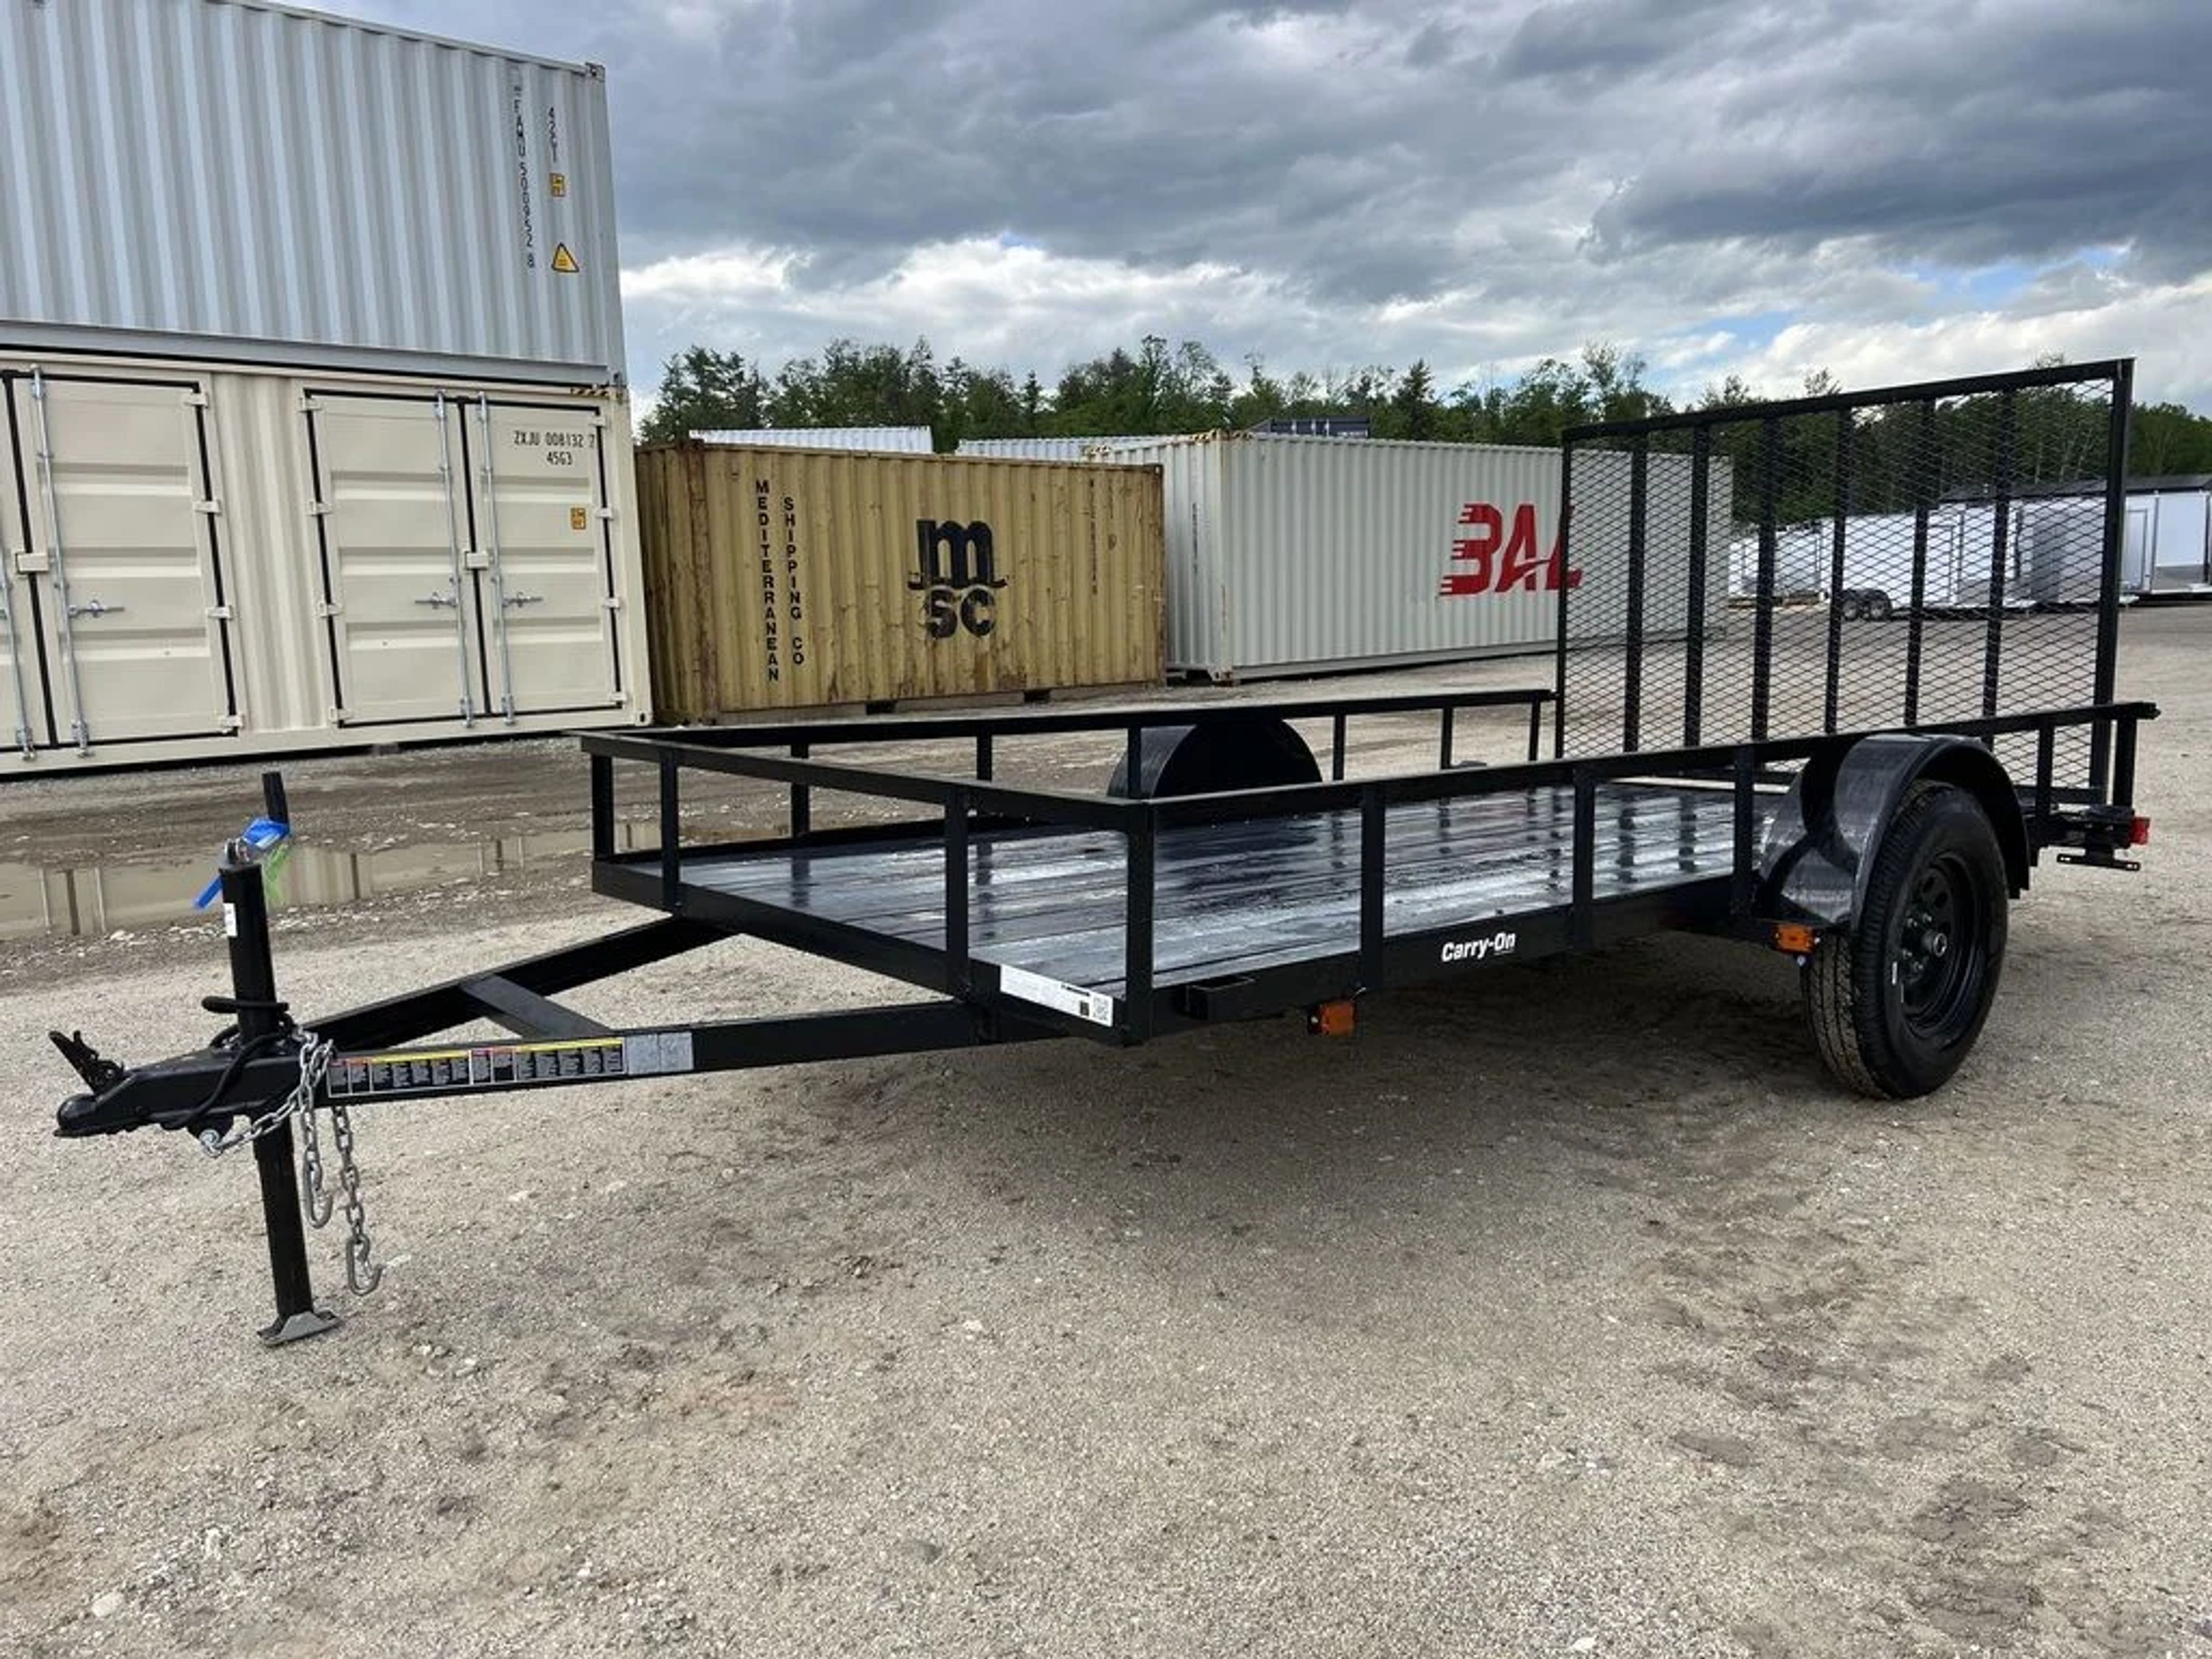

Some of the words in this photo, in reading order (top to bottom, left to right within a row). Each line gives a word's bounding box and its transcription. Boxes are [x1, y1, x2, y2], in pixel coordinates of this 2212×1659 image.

[546, 431, 584, 448] 008132
[783, 497, 802, 620] SHIPPING
[756, 479, 779, 681] MEDITERRANEAN
[792, 637, 805, 665] CO
[1442, 932, 1516, 962] Carry-On
